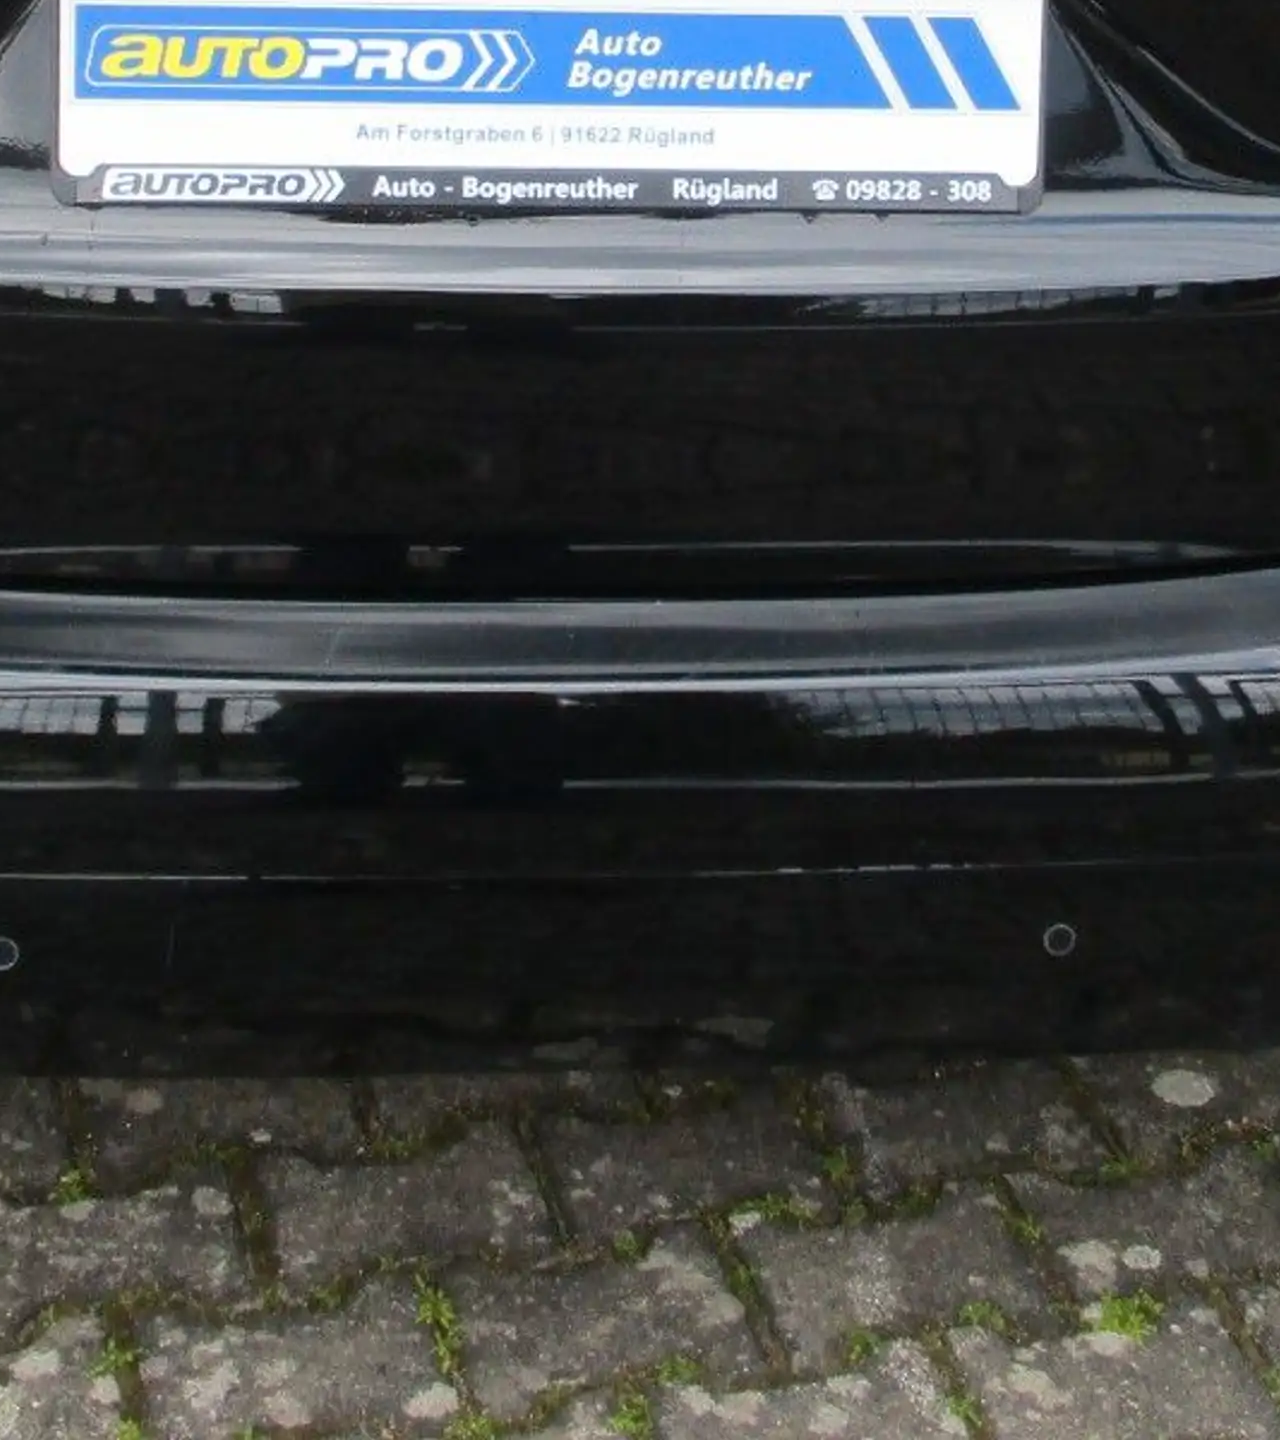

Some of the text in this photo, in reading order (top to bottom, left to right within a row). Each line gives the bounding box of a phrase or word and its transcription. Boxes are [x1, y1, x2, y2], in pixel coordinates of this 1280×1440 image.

[574, 27, 663, 56] Auto
[567, 61, 812, 97] Bogenreuther
[356, 123, 391, 142] Am
[395, 124, 526, 145] Forstgraben
[531, 126, 545, 143] 6
[561, 126, 622, 144] 91622
[627, 125, 716, 148] Rügland
[372, 175, 437, 199] Auto
[462, 175, 639, 203] Bogenreuther
[672, 176, 779, 205] Rügland
[846, 178, 922, 202] 09828
[946, 178, 993, 203] 308
